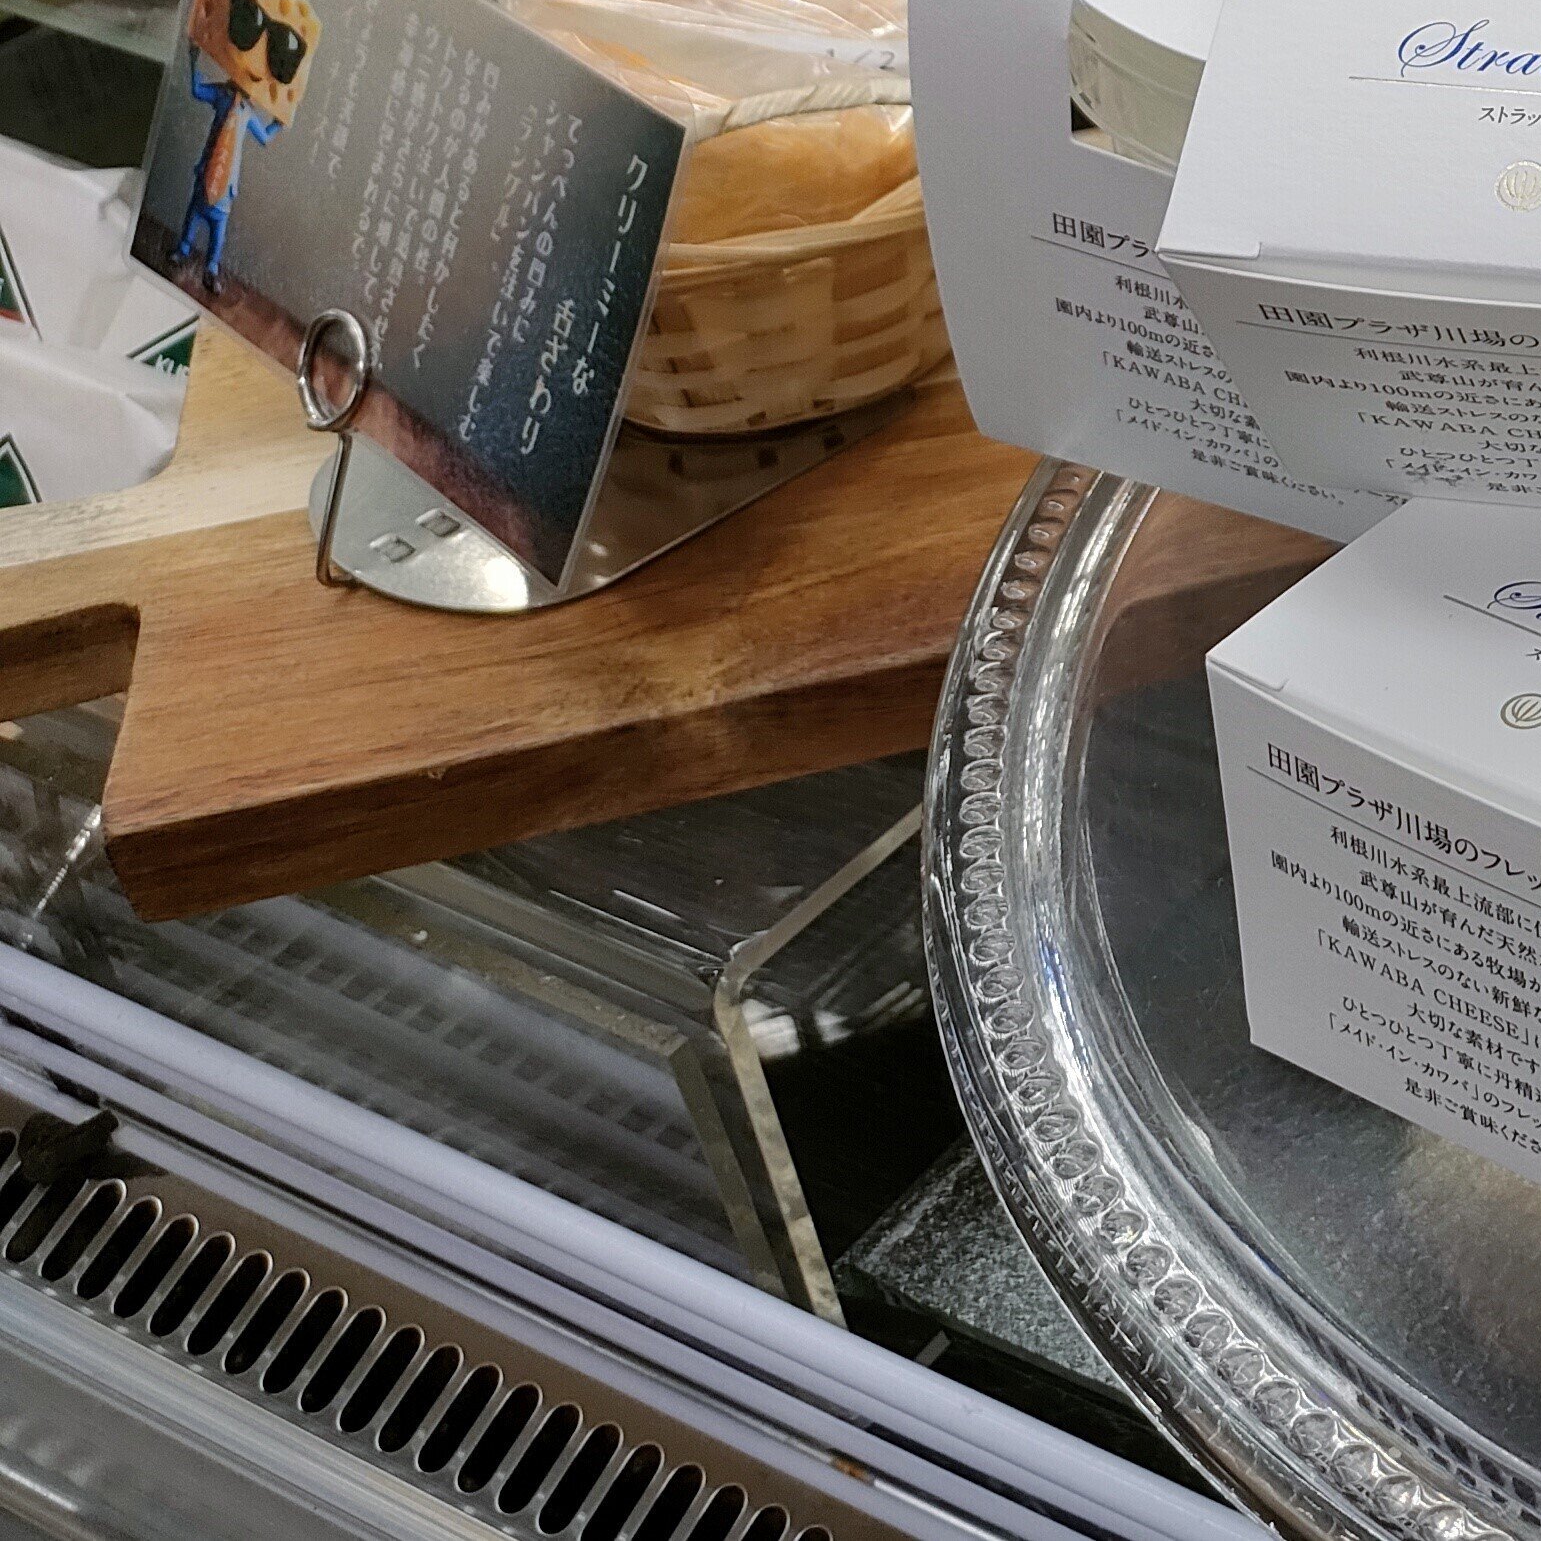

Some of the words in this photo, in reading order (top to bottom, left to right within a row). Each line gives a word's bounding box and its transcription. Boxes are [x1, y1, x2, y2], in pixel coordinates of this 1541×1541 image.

[572, 153, 650, 397] クリーミーな
[520, 297, 576, 456] 舌ざわり
[1102, 351, 1206, 396] 「KAWABA
[1317, 928, 1426, 998] 「KAWABA
